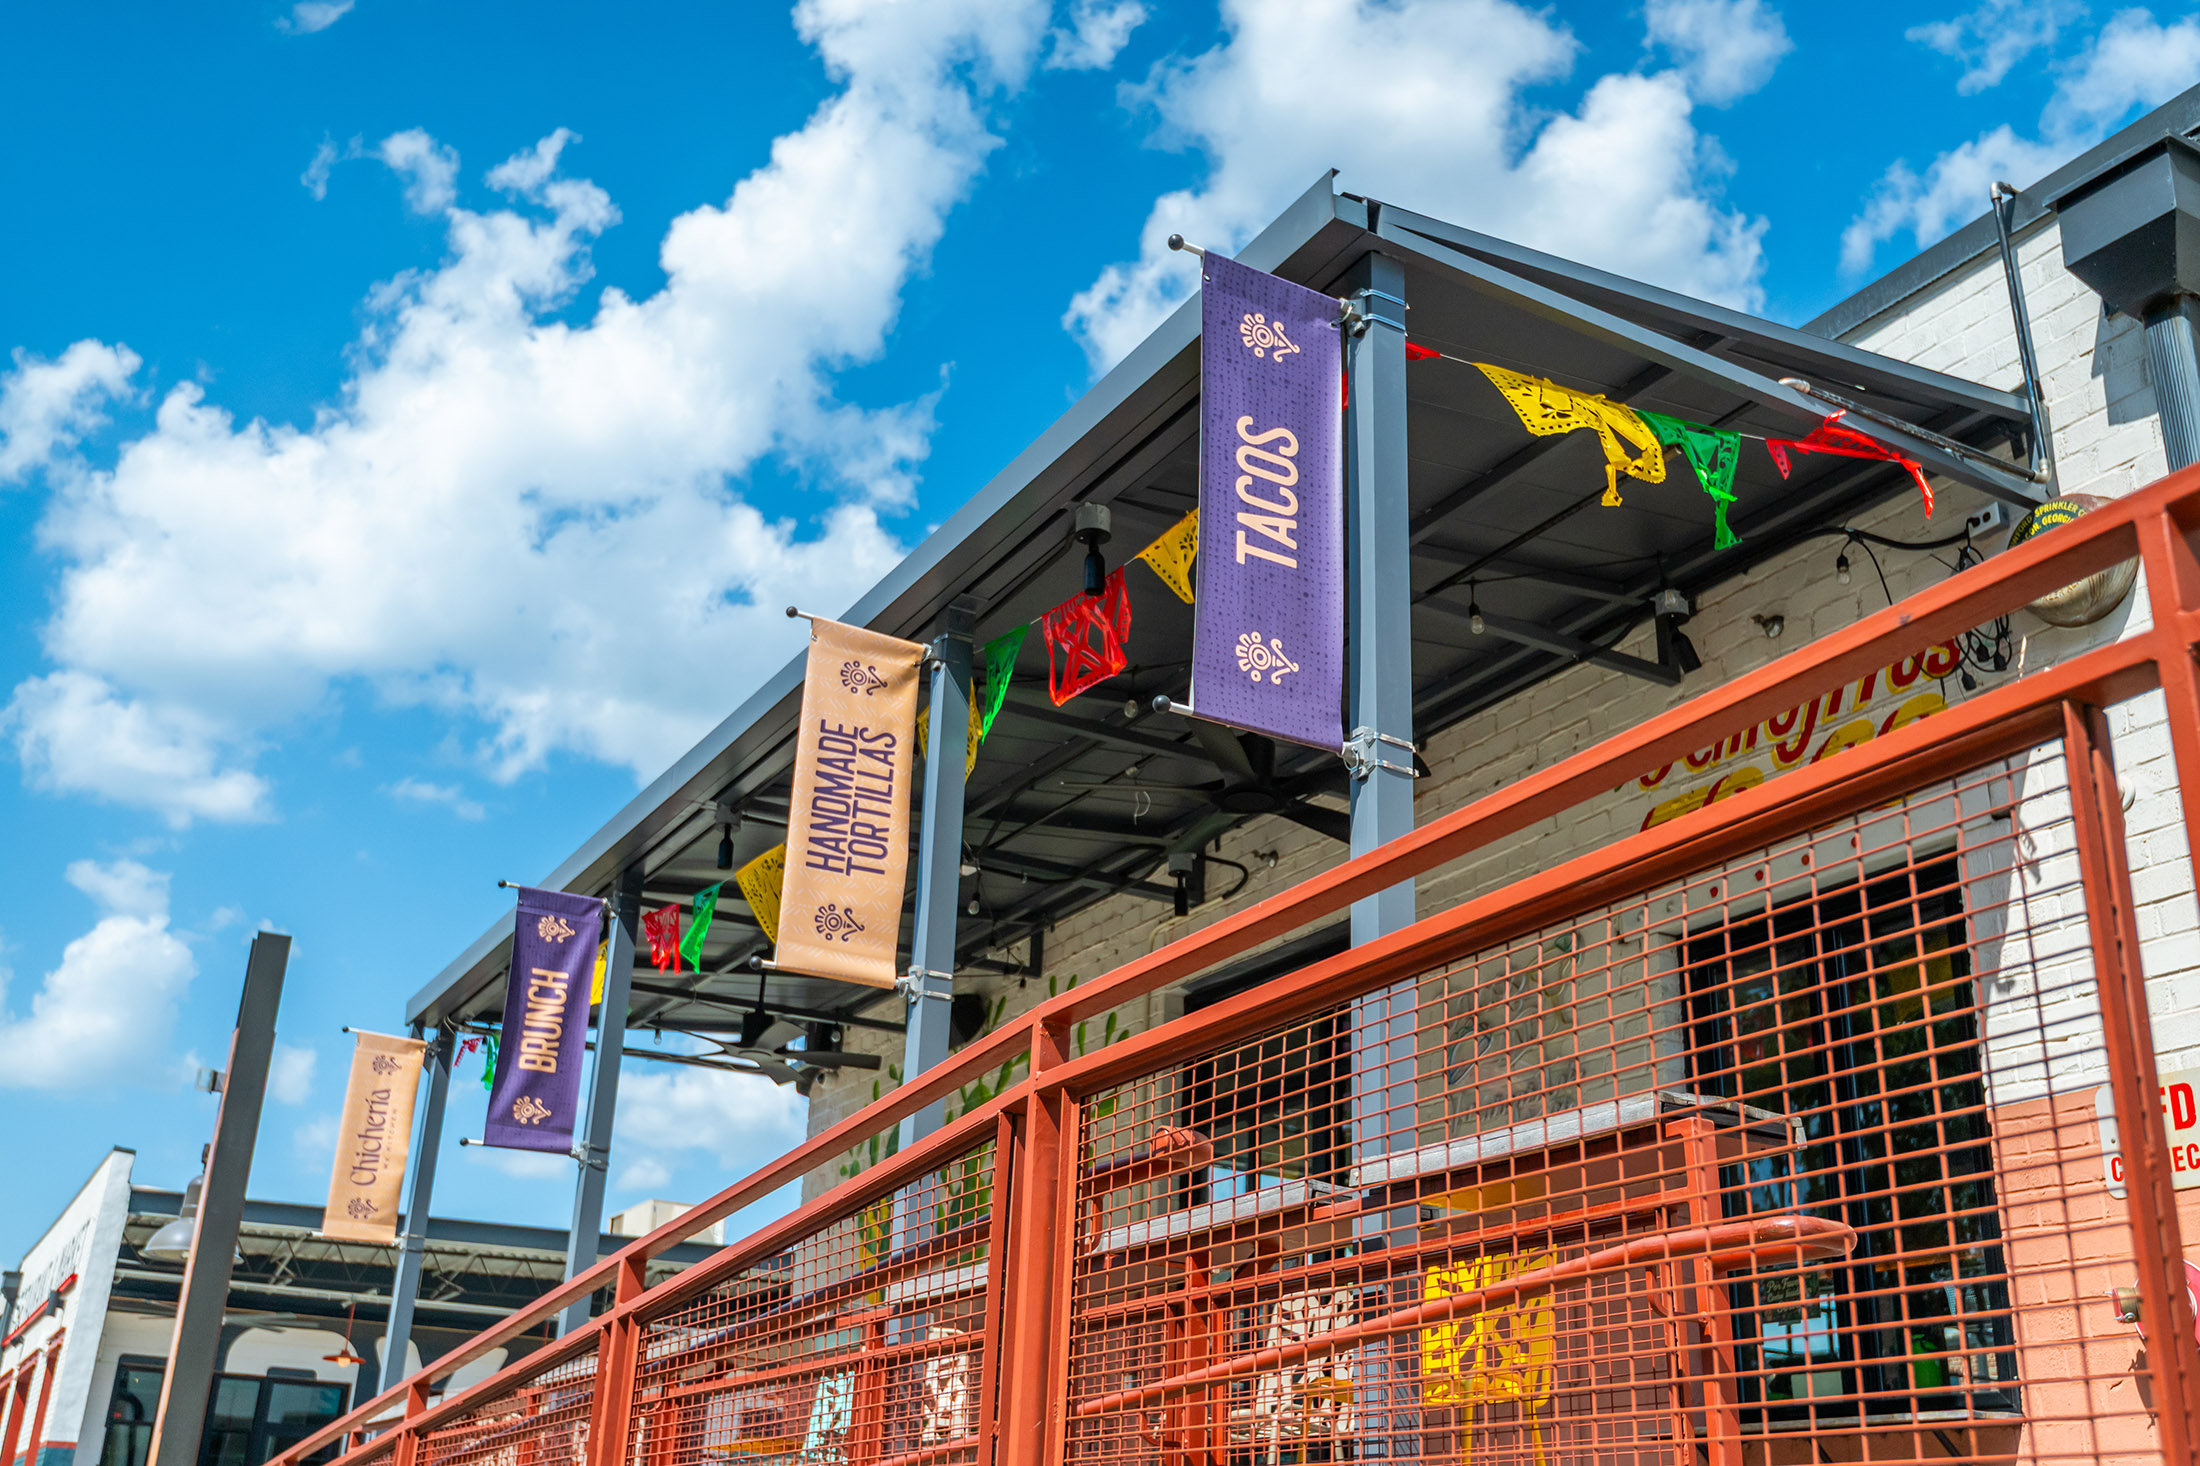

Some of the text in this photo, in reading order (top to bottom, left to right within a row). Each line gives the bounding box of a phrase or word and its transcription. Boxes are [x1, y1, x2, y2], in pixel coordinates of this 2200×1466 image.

[1235, 415, 1299, 568] TACOS
[2034, 501, 2078, 517] SPRINKLER
[2077, 509, 2087, 518] C
[805, 719, 859, 875] HANDMADE
[845, 727, 897, 877] TORTILLAS
[518, 967, 570, 1074] BRUNCH
[350, 1088, 391, 1186] Chichería
[2160, 1083, 2197, 1131] D
